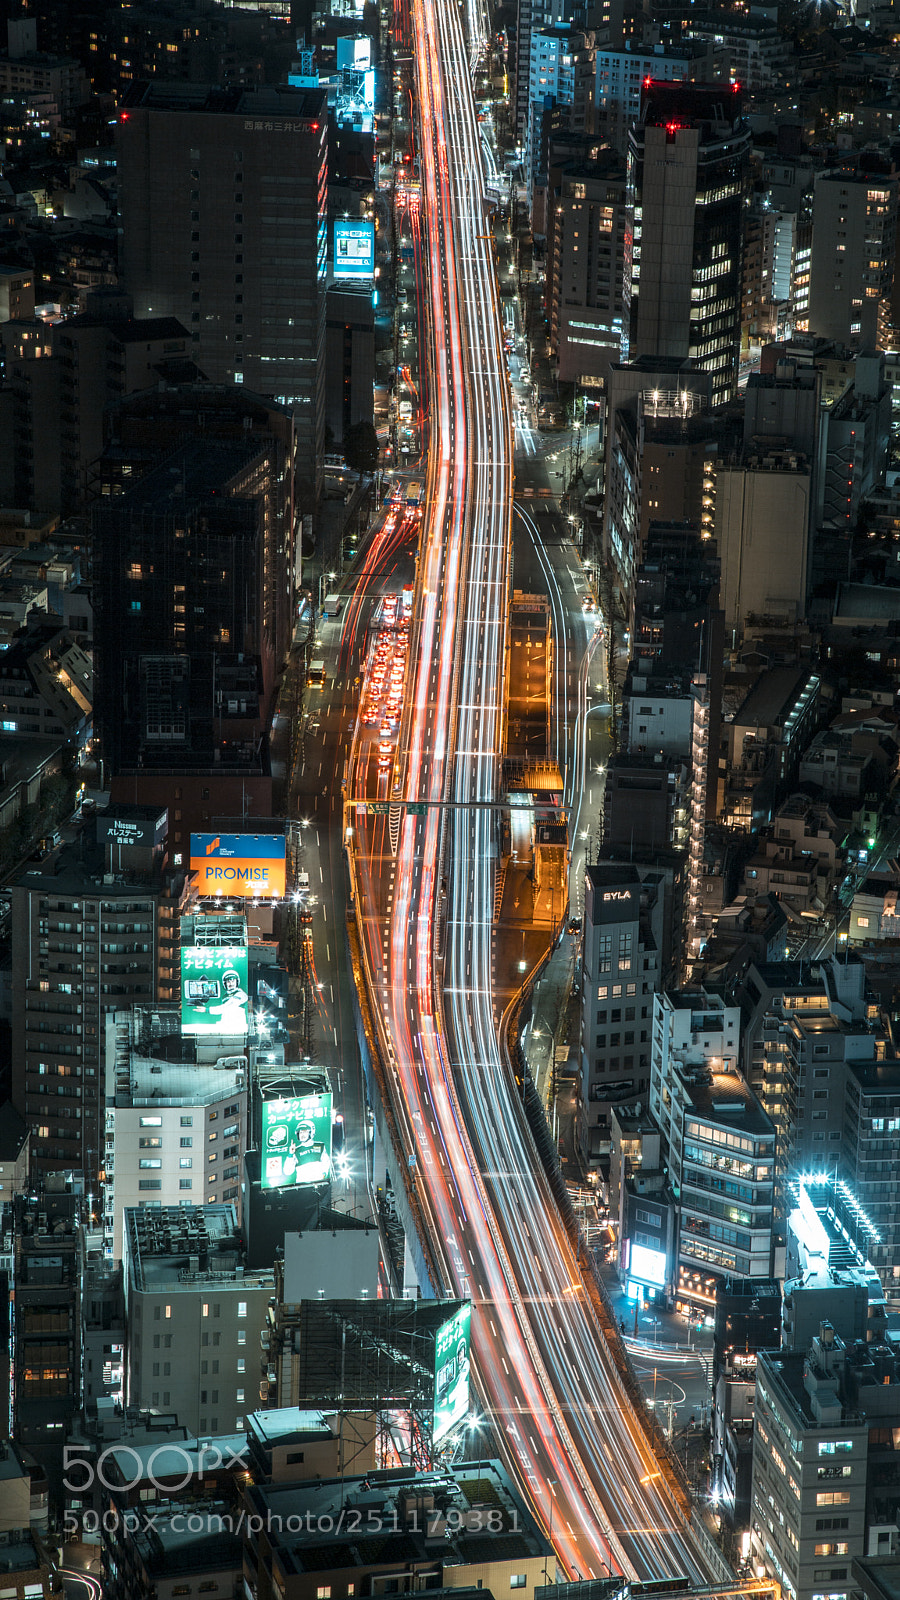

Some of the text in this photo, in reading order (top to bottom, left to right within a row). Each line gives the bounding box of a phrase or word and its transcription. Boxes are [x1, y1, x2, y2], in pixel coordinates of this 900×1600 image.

[206, 867, 269, 880] PROMISE
[184, 959, 233, 969] ナビタイム
